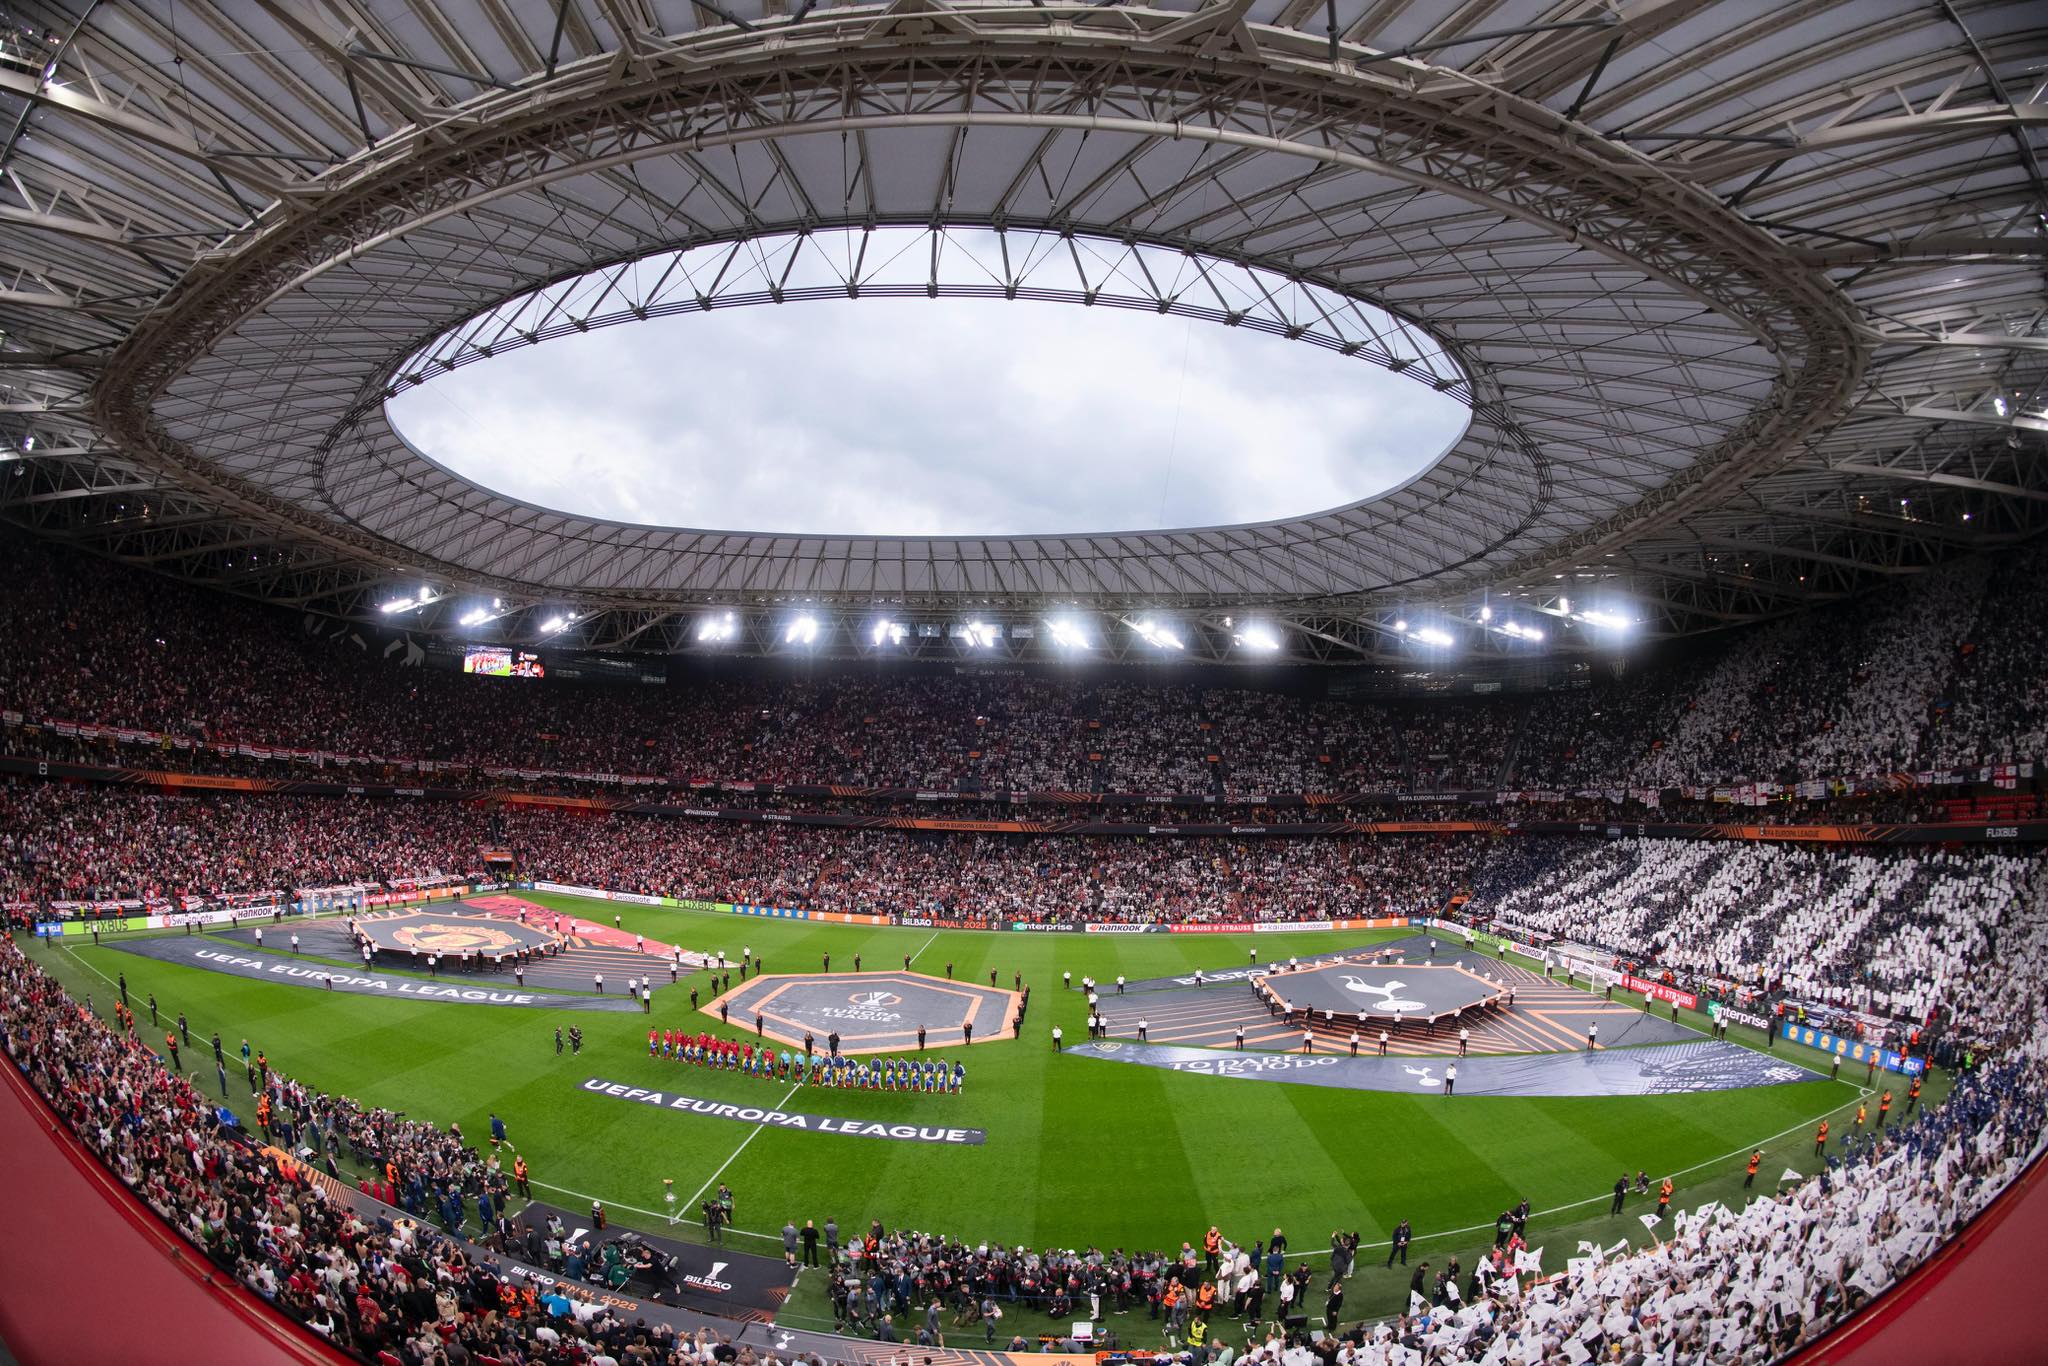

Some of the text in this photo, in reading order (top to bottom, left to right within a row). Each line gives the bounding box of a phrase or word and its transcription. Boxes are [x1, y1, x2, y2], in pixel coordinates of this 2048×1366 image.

[614, 893, 650, 904] Swissquote
[171, 914, 214, 926] Swisqote
[934, 920, 961, 928] FINAL
[964, 921, 986, 929] 2025
[1016, 923, 1073, 932] enterprise
[195, 949, 536, 1004] UEFA EUROPA LEAGUE
[1172, 970, 1269, 985] BLBAO
[1630, 978, 1656, 993] STRAUSS
[822, 1007, 902, 1018] EUROPA
[824, 1012, 892, 1022] LEAGUE
[1712, 1004, 1768, 1028] enterprise
[1169, 1055, 1299, 1070] TO DARE
[1218, 1066, 1244, 1074] IS
[1296, 1057, 1338, 1068] DO
[584, 1079, 664, 1104] UEFA
[670, 1097, 808, 1128] EUROPA
[818, 1118, 968, 1142] LEAGUE
[556, 1281, 596, 1300] FINAL
[600, 1295, 638, 1312] 2025
